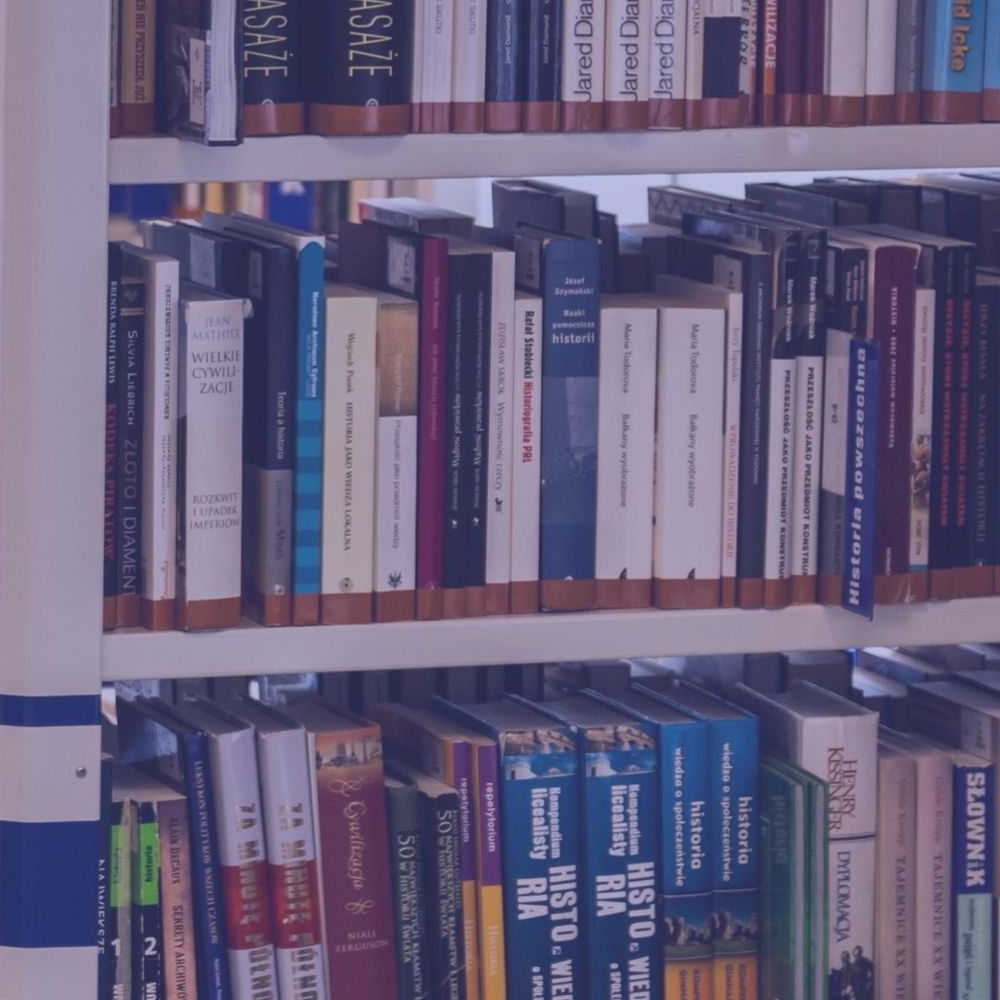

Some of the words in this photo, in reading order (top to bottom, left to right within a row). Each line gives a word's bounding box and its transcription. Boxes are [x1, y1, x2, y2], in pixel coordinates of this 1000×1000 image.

[950, 24, 969, 71] Icke
[577, 42, 593, 102] Jared
[623, 42, 639, 102] Jared
[657, 42, 673, 100] Jared
[524, 310, 535, 335] Rafał
[552, 333, 595, 344] historii
[623, 323, 633, 349] Maria
[690, 323, 700, 349] Maria
[127, 330, 138, 368] SILVIA
[192, 350, 239, 363] WIELKIE
[523, 338, 535, 379] Stobiecki
[200, 382, 234, 395] ZACJE
[622, 351, 632, 393] Todorova
[689, 351, 700, 393] Todorova
[126, 372, 137, 426] LIEBRICH
[804, 367, 816, 432] PRZESZŁOŚĆ
[345, 402, 354, 446] HISTORIA
[853, 348, 867, 500] powszechna
[123, 439, 137, 498] ZŁOTO
[343, 448, 353, 469] JAKO
[522, 445, 533, 464] PRL
[781, 436, 789, 464] JAKO
[804, 434, 813, 461] JAKO
[344, 471, 352, 506] WIEDZA
[618, 451, 630, 508] wyobrażone
[685, 451, 698, 508] wyobrażone
[803, 464, 813, 521] PRZEDMIOT
[849, 507, 863, 605] Historia
[674, 747, 685, 787] wiedza
[721, 742, 733, 782] wiedza
[675, 790, 683, 798] o
[722, 785, 731, 793] o
[827, 746, 844, 831] KISSINGER
[841, 760, 858, 818] HENRY
[438, 810, 452, 833] 50
[460, 778, 472, 843] repetytorium
[485, 782, 498, 852] repetytorium
[529, 788, 548, 860] licealisty
[549, 787, 562, 859] Kompendium
[608, 784, 627, 856] licealisty
[628, 784, 641, 856] Kompendium
[737, 796, 753, 865] historia
[344, 800, 367, 890] Cywilizacja
[397, 834, 415, 858] 50
[690, 800, 705, 870] historia
[145, 845, 153, 882] historia
[170, 848, 181, 885] DECAUX
[516, 877, 548, 920] RIA
[549, 864, 578, 942] HISTO
[596, 874, 626, 917] RIA
[627, 862, 656, 938] HISTO
[834, 851, 851, 943] DYPLOMACJA
[895, 856, 907, 945] TAJEMNICE
[932, 854, 944, 941] TAJEMNICE
[145, 937, 157, 956] 2
[172, 905, 185, 948] SEKRETY
[896, 949, 906, 969] XX
[933, 945, 944, 965] XX
